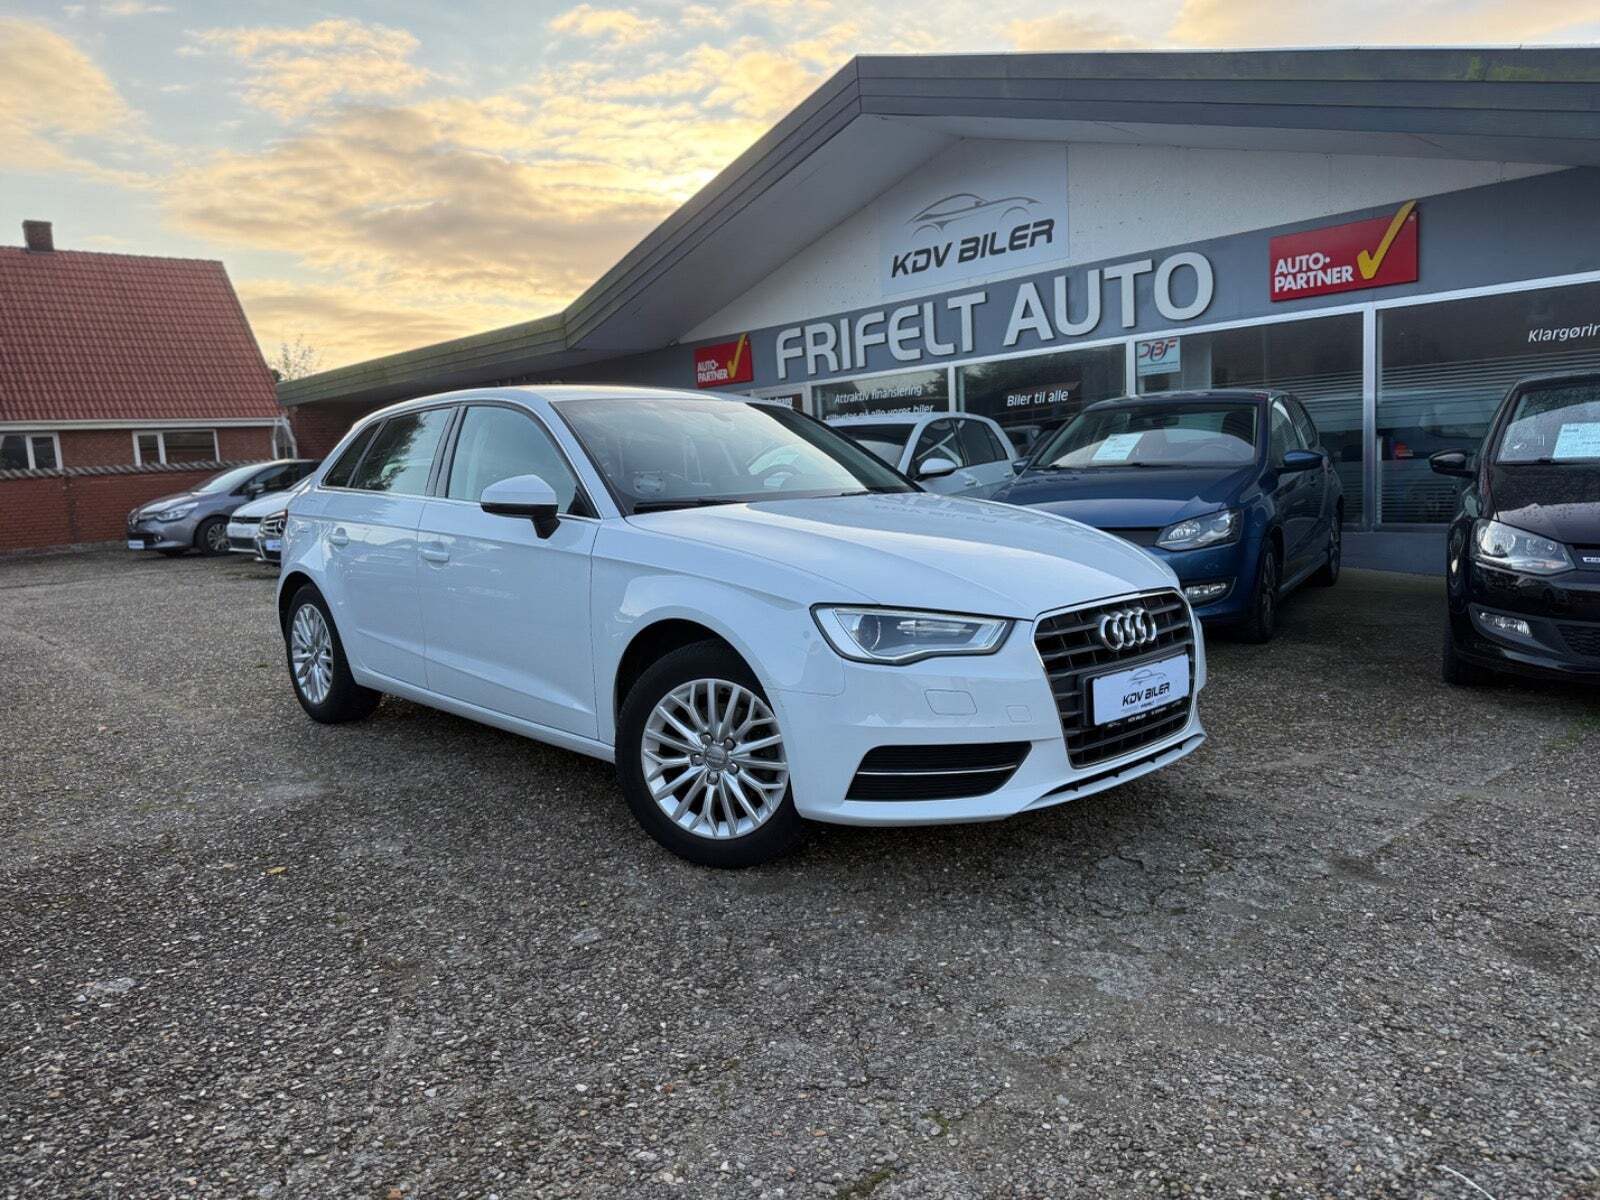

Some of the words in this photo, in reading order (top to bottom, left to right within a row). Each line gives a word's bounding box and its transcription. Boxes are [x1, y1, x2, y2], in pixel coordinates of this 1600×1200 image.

[891, 242, 952, 278] KDV
[958, 218, 1055, 263] BILER
[1274, 265, 1354, 293] PARTNER
[776, 291, 987, 380] FRIFELT
[1003, 252, 1214, 346] AUTO
[697, 369, 728, 383] PARTNER
[834, 391, 869, 404] Attraktiv
[871, 384, 922, 400] finansiering
[1006, 394, 1032, 407] Biler
[1034, 391, 1046, 404] til
[1048, 389, 1069, 402] alle
[1122, 690, 1143, 706] KDV
[1145, 682, 1170, 700] BILER
